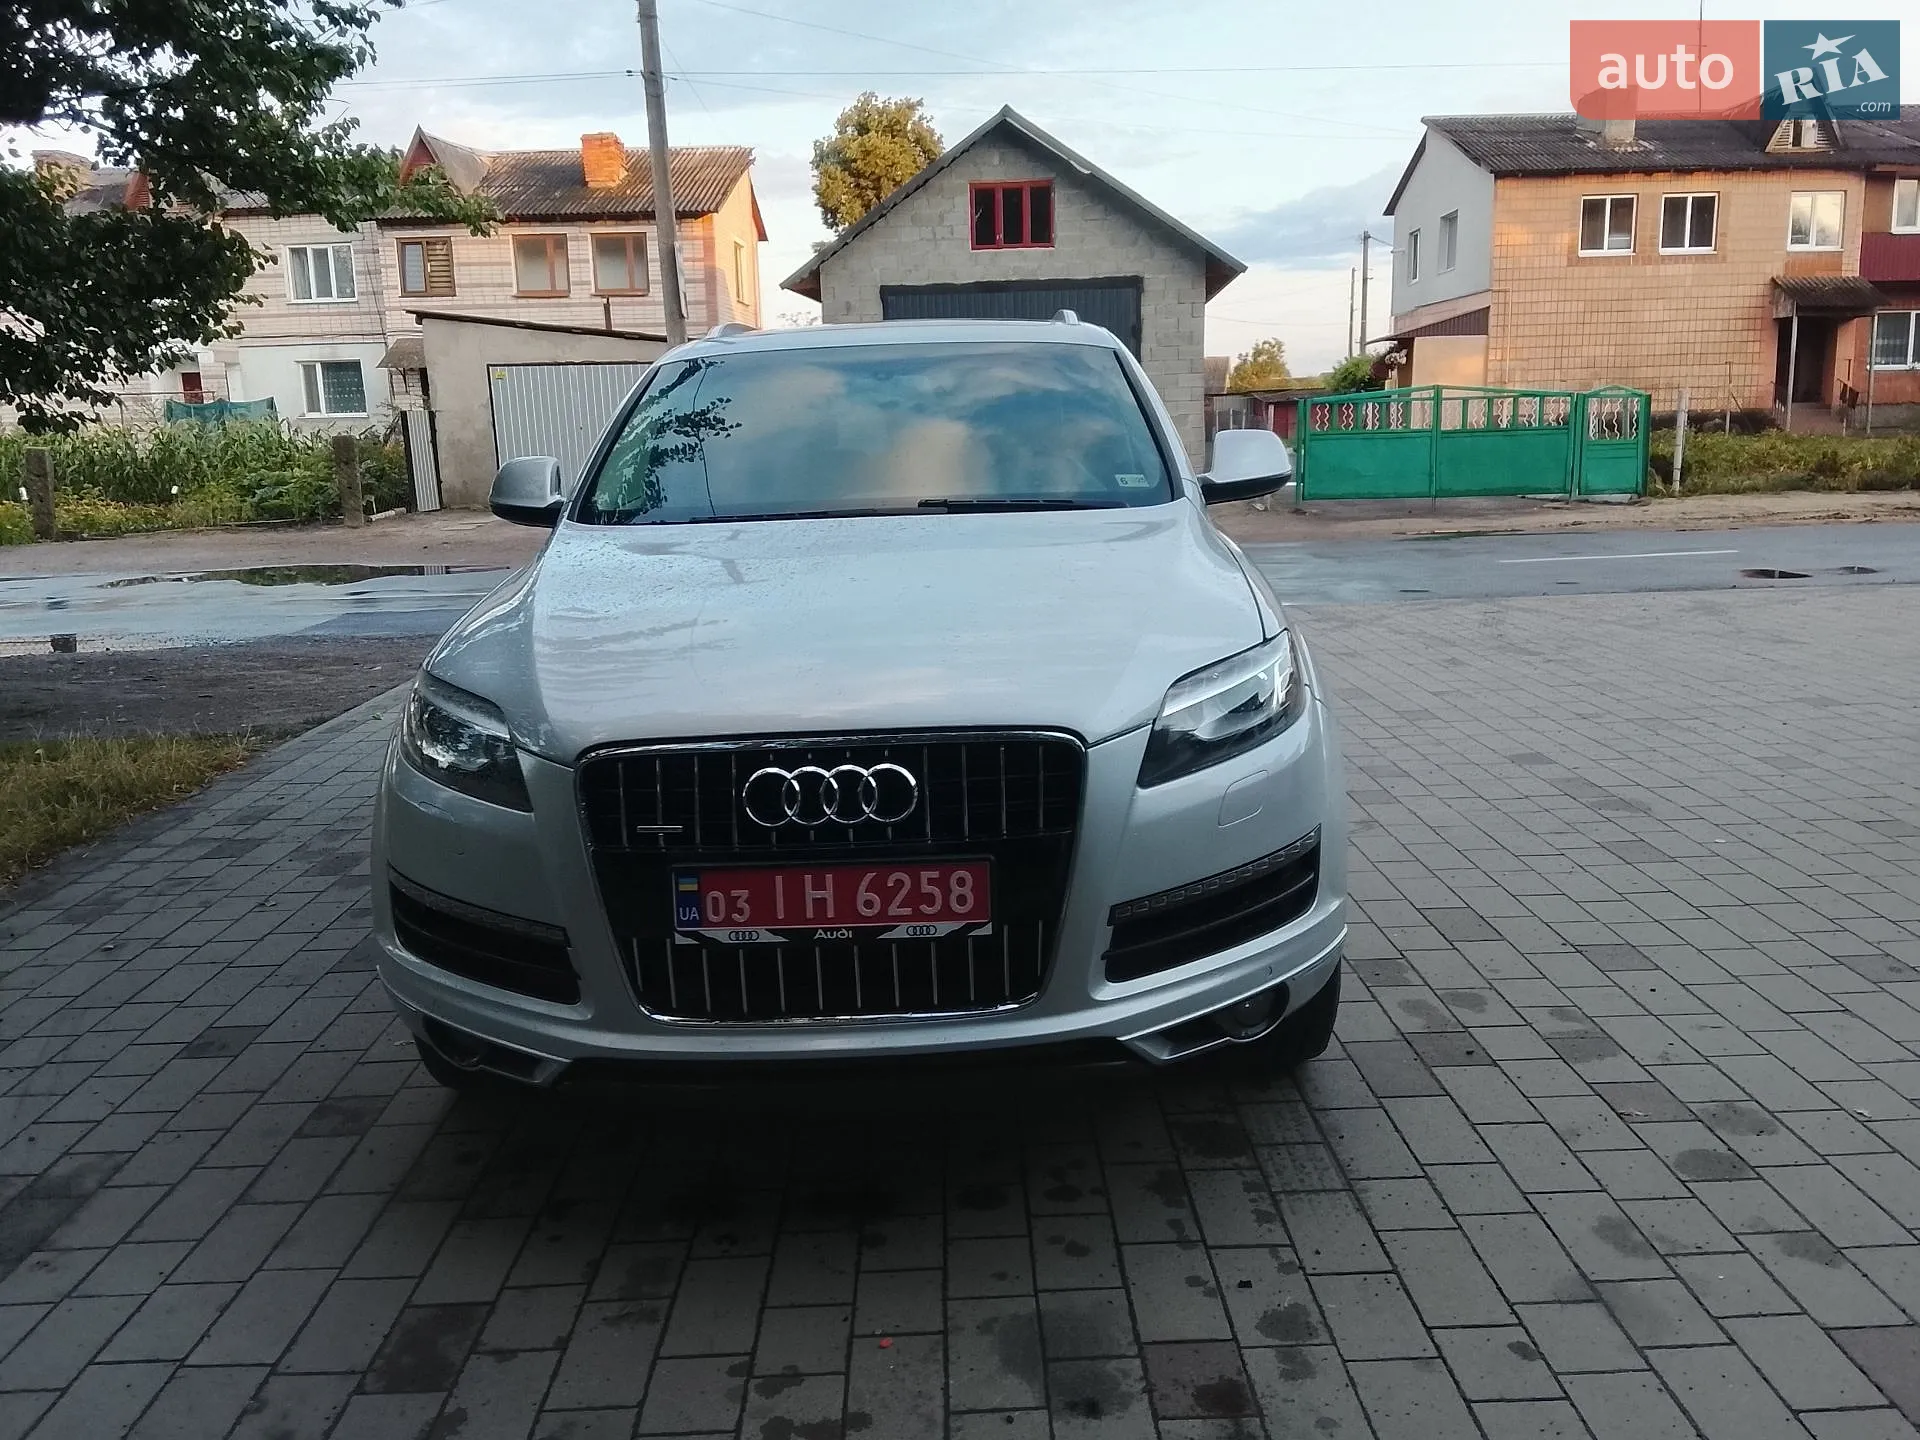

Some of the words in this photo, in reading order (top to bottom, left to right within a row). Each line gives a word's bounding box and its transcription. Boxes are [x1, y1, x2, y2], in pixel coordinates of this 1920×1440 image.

[705, 889, 751, 923] 03
[856, 869, 975, 918] 6258
[679, 907, 699, 921] UA
[813, 928, 853, 940] Audi
